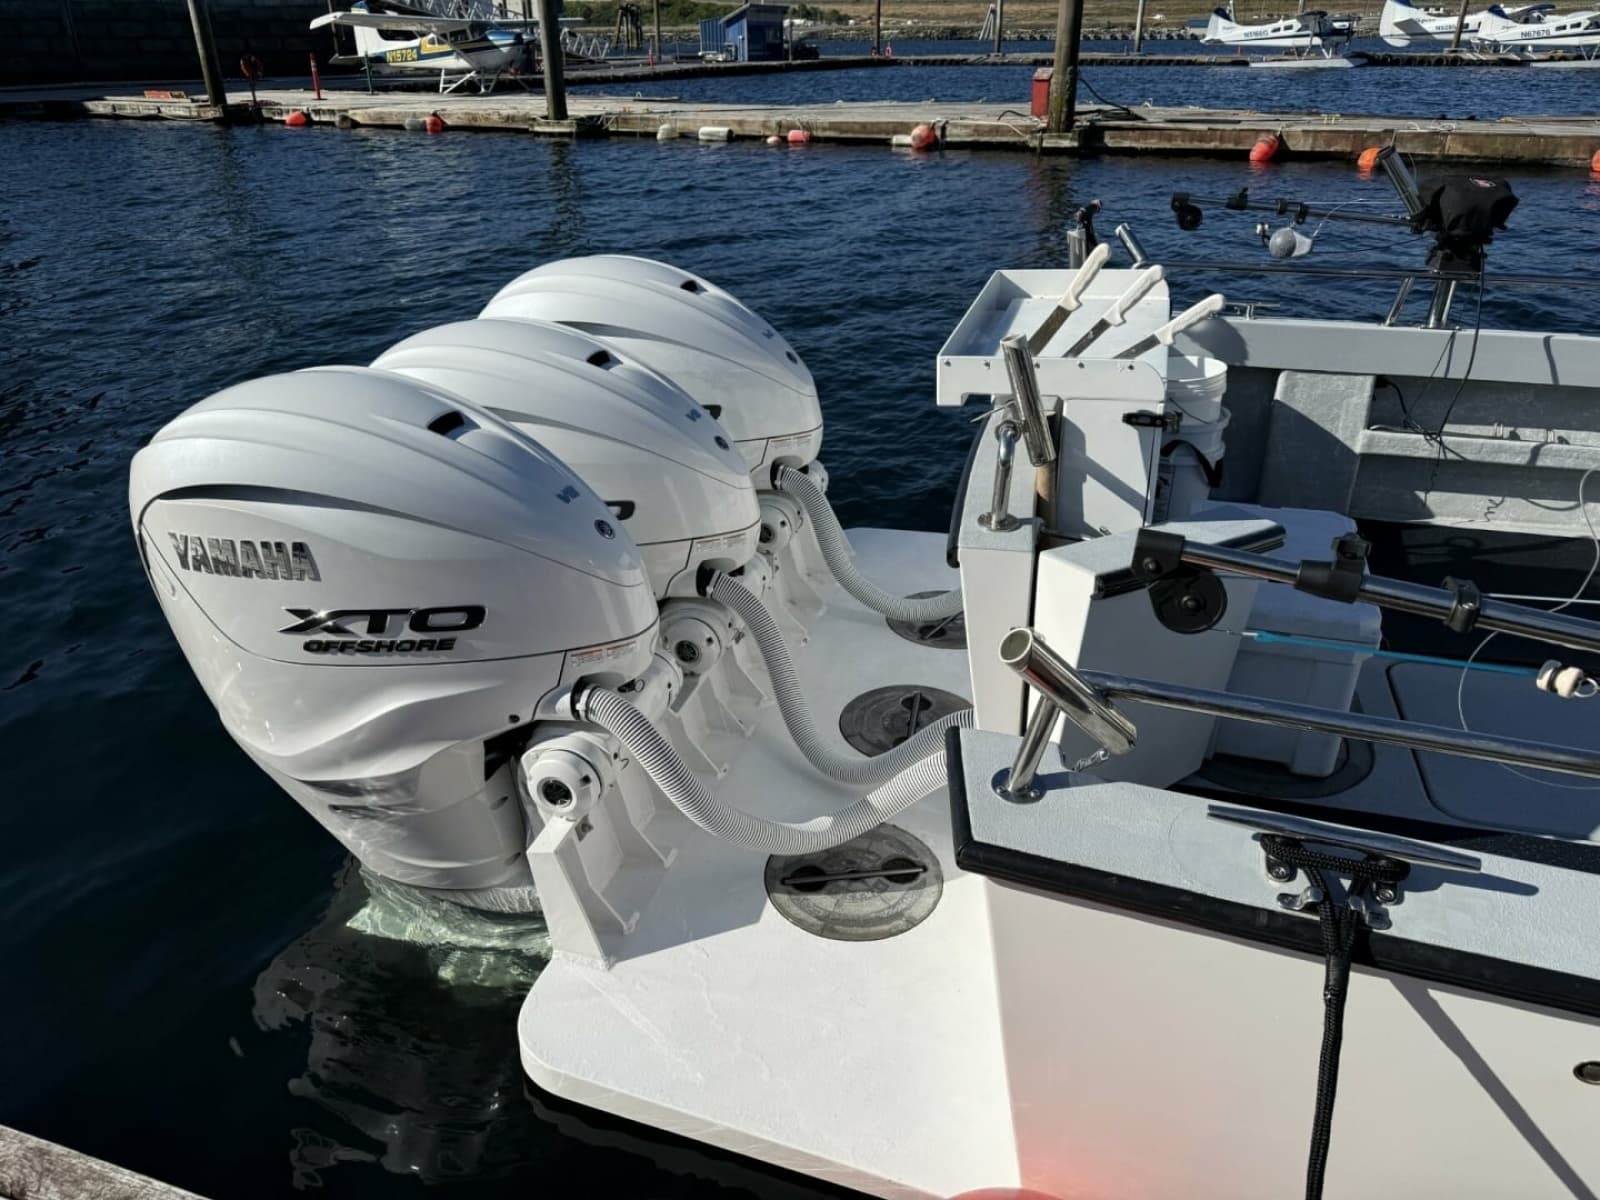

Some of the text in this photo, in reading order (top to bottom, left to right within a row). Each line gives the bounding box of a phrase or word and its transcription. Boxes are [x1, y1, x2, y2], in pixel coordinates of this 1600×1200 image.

[386, 48, 417, 64] N15724
[168, 532, 321, 582] YAMAHA
[277, 605, 488, 637] XTO
[302, 637, 456, 654] OFFSHORE
